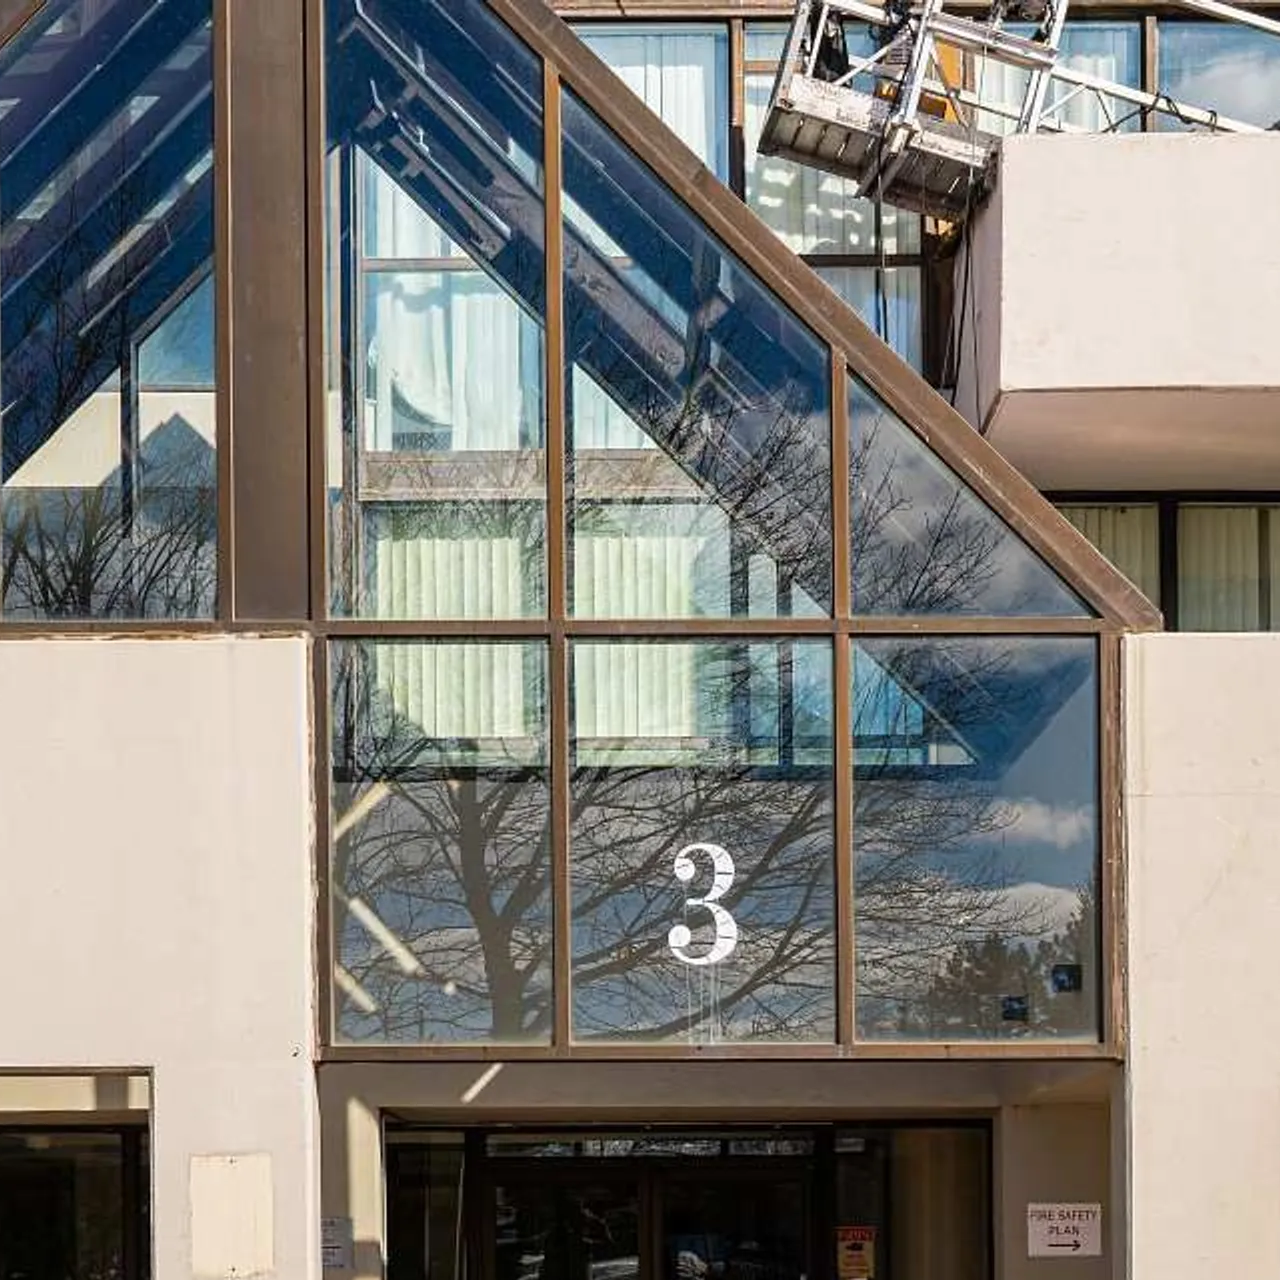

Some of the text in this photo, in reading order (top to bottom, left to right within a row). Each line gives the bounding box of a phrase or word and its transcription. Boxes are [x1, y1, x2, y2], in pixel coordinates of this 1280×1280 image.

[668, 843, 738, 965] 3
[1029, 1209, 1097, 1221] FIRE SAFETY
[1047, 1225, 1080, 1236] PLAN
